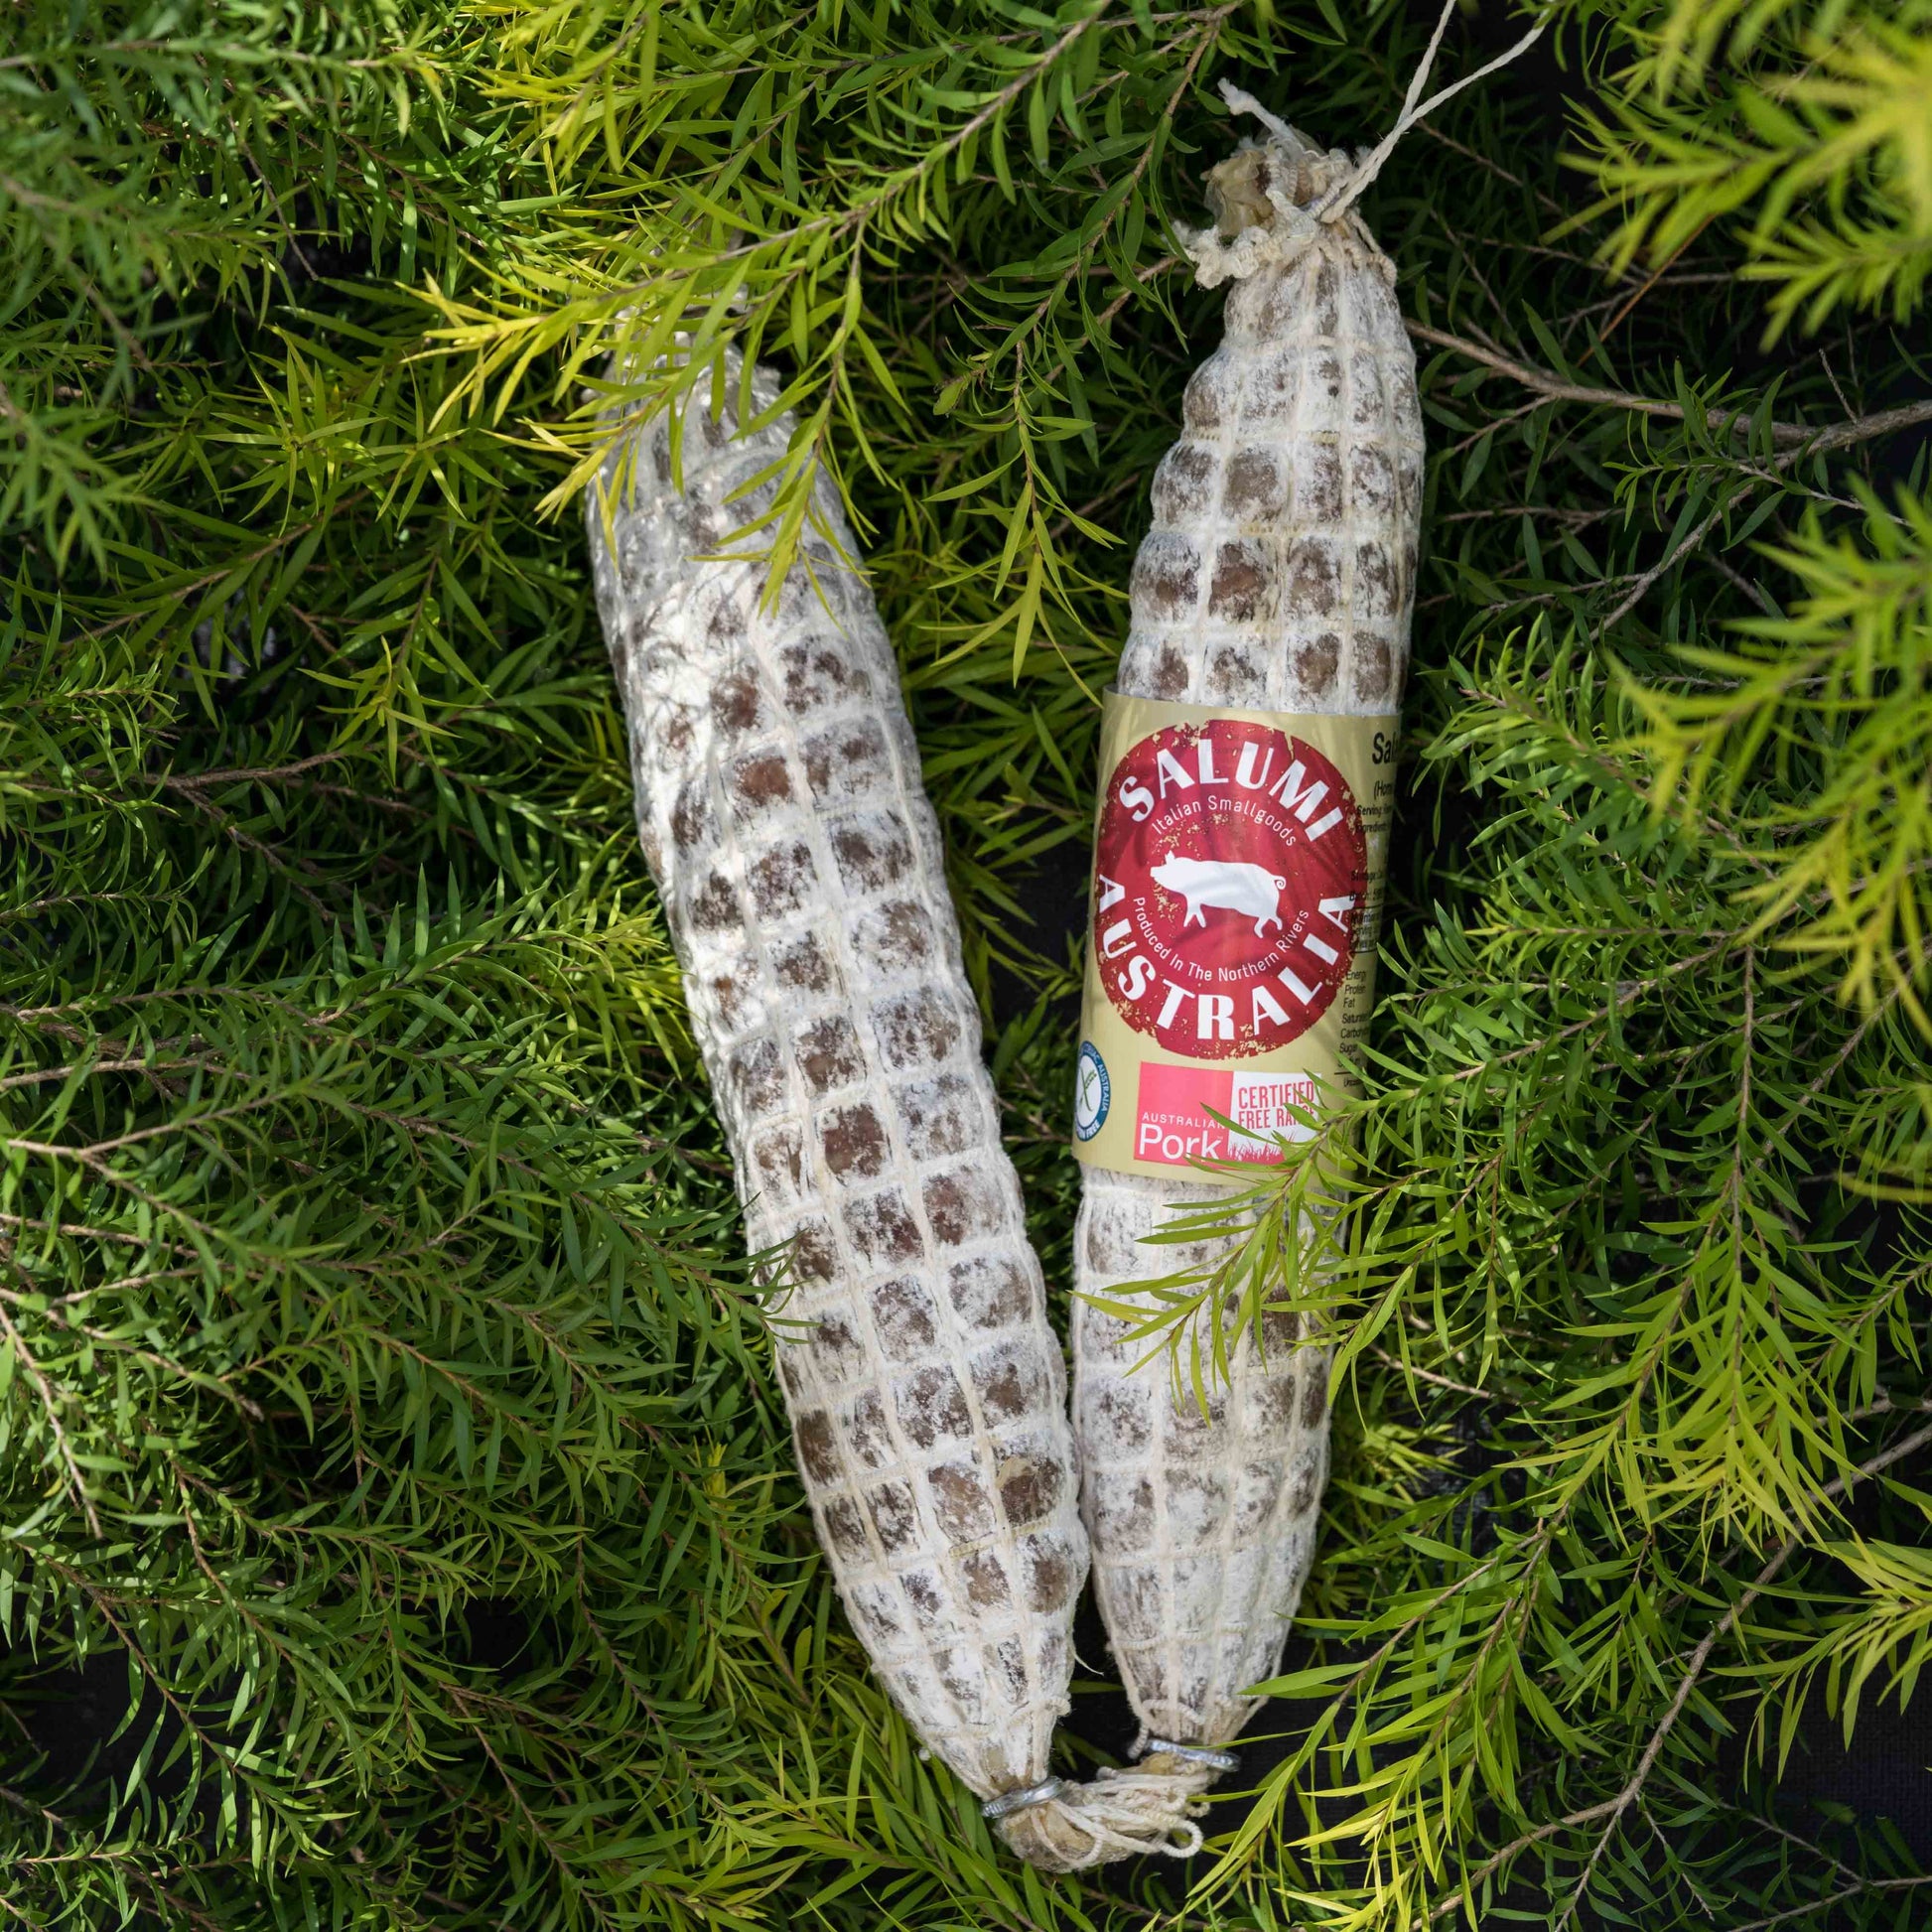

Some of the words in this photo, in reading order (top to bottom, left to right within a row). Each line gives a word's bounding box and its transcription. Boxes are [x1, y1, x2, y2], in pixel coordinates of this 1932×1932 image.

[1119, 739, 1343, 842] SALUMI
[1152, 800, 1201, 835] Italian
[1208, 795, 1297, 846] Smallgoods
[1099, 874, 1357, 1040] AUSTRALIA
[1133, 897, 1171, 960] Produced
[1170, 954, 1184, 971] In
[1187, 961, 1212, 981] The
[1218, 953, 1280, 982] Northern
[1276, 909, 1310, 953] Rivers
[1343, 998, 1355, 1008] Fat
[1238, 1080, 1314, 1109] CERTIFIED
[1238, 1109, 1271, 1130] FREE
[1139, 1123, 1222, 1162] Pork
